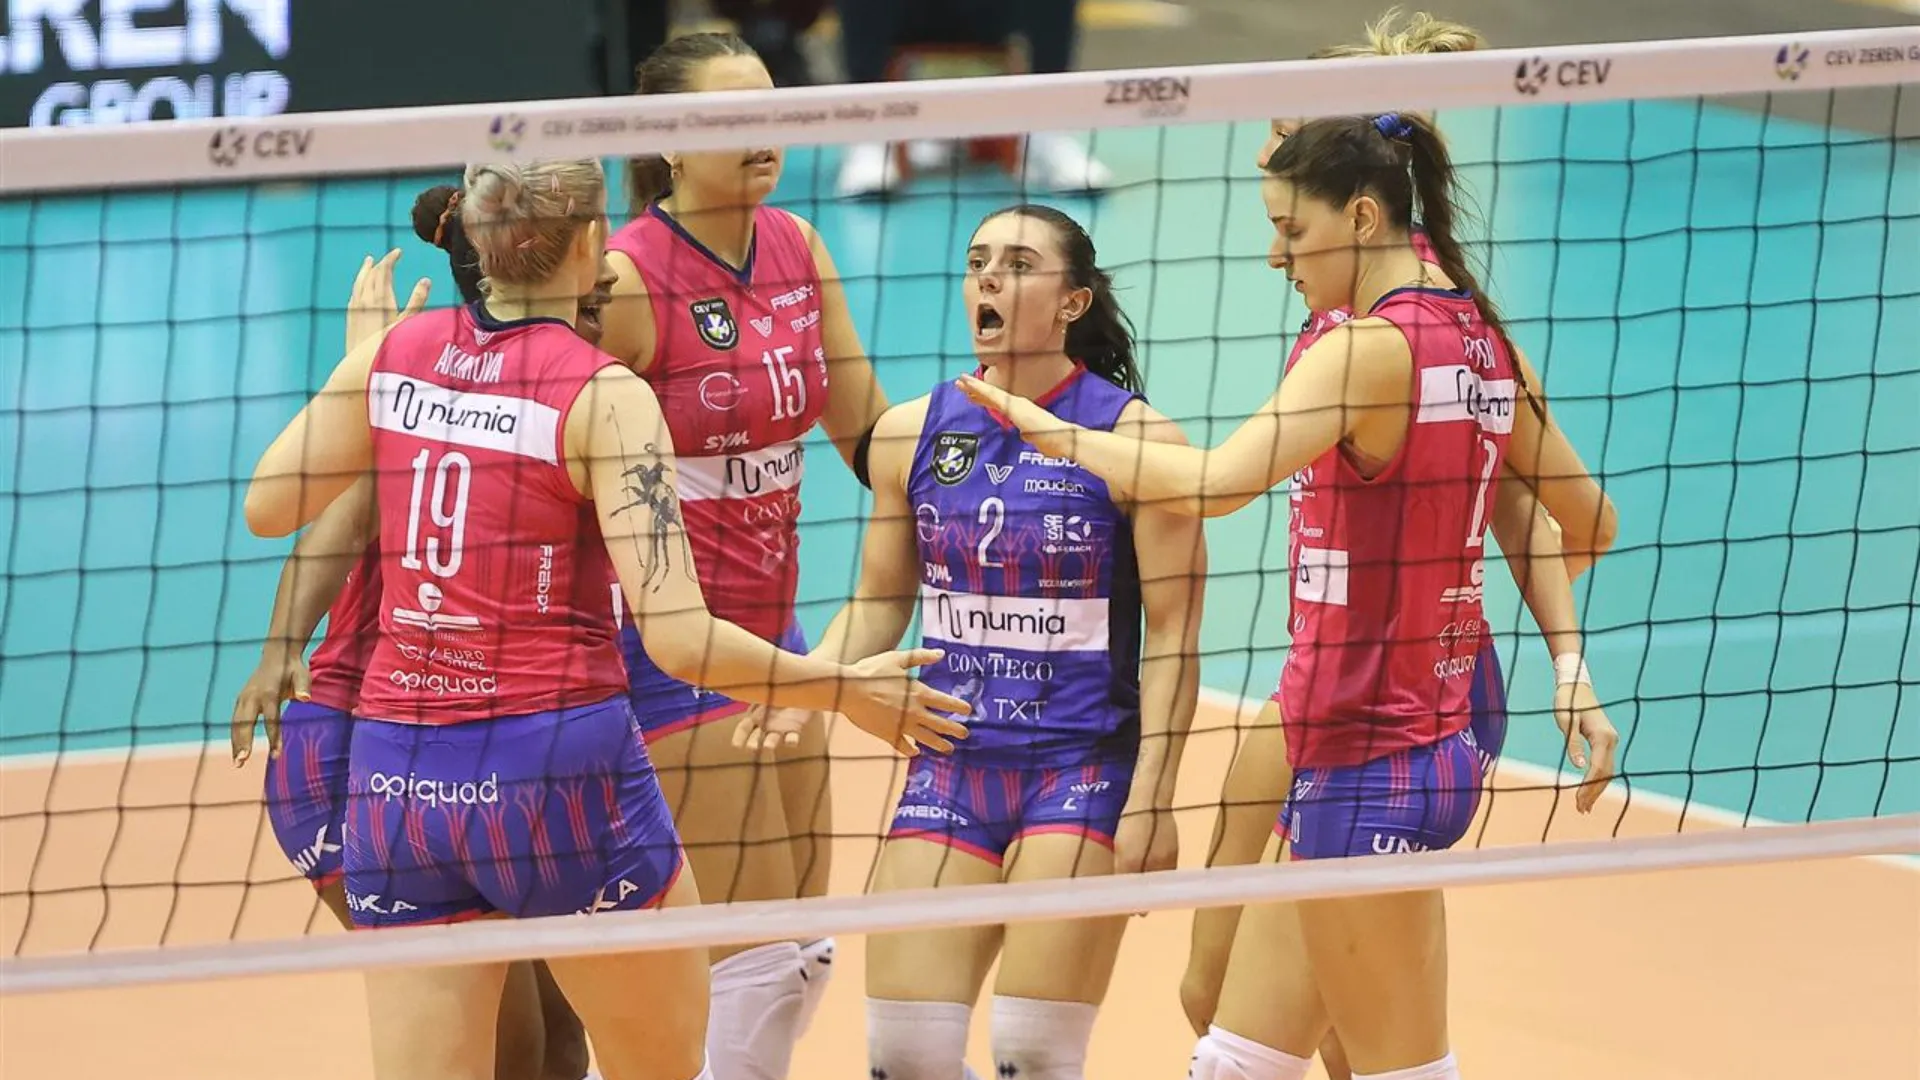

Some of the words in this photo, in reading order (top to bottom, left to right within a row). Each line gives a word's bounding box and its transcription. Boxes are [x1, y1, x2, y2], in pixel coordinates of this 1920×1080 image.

[0, 0, 291, 74] REN
[1557, 59, 1612, 87] CEV
[1825, 49, 1856, 66] CEV
[1104, 76, 1191, 104] ZEREN
[253, 126, 315, 158] CEV
[762, 345, 806, 421] 15
[427, 402, 517, 434] numia
[763, 447, 804, 477] num
[401, 448, 472, 578] 19
[978, 496, 1004, 568] 2
[968, 607, 1066, 635] numia
[948, 651, 1053, 682] CONTECO
[993, 698, 1048, 721] TXT
